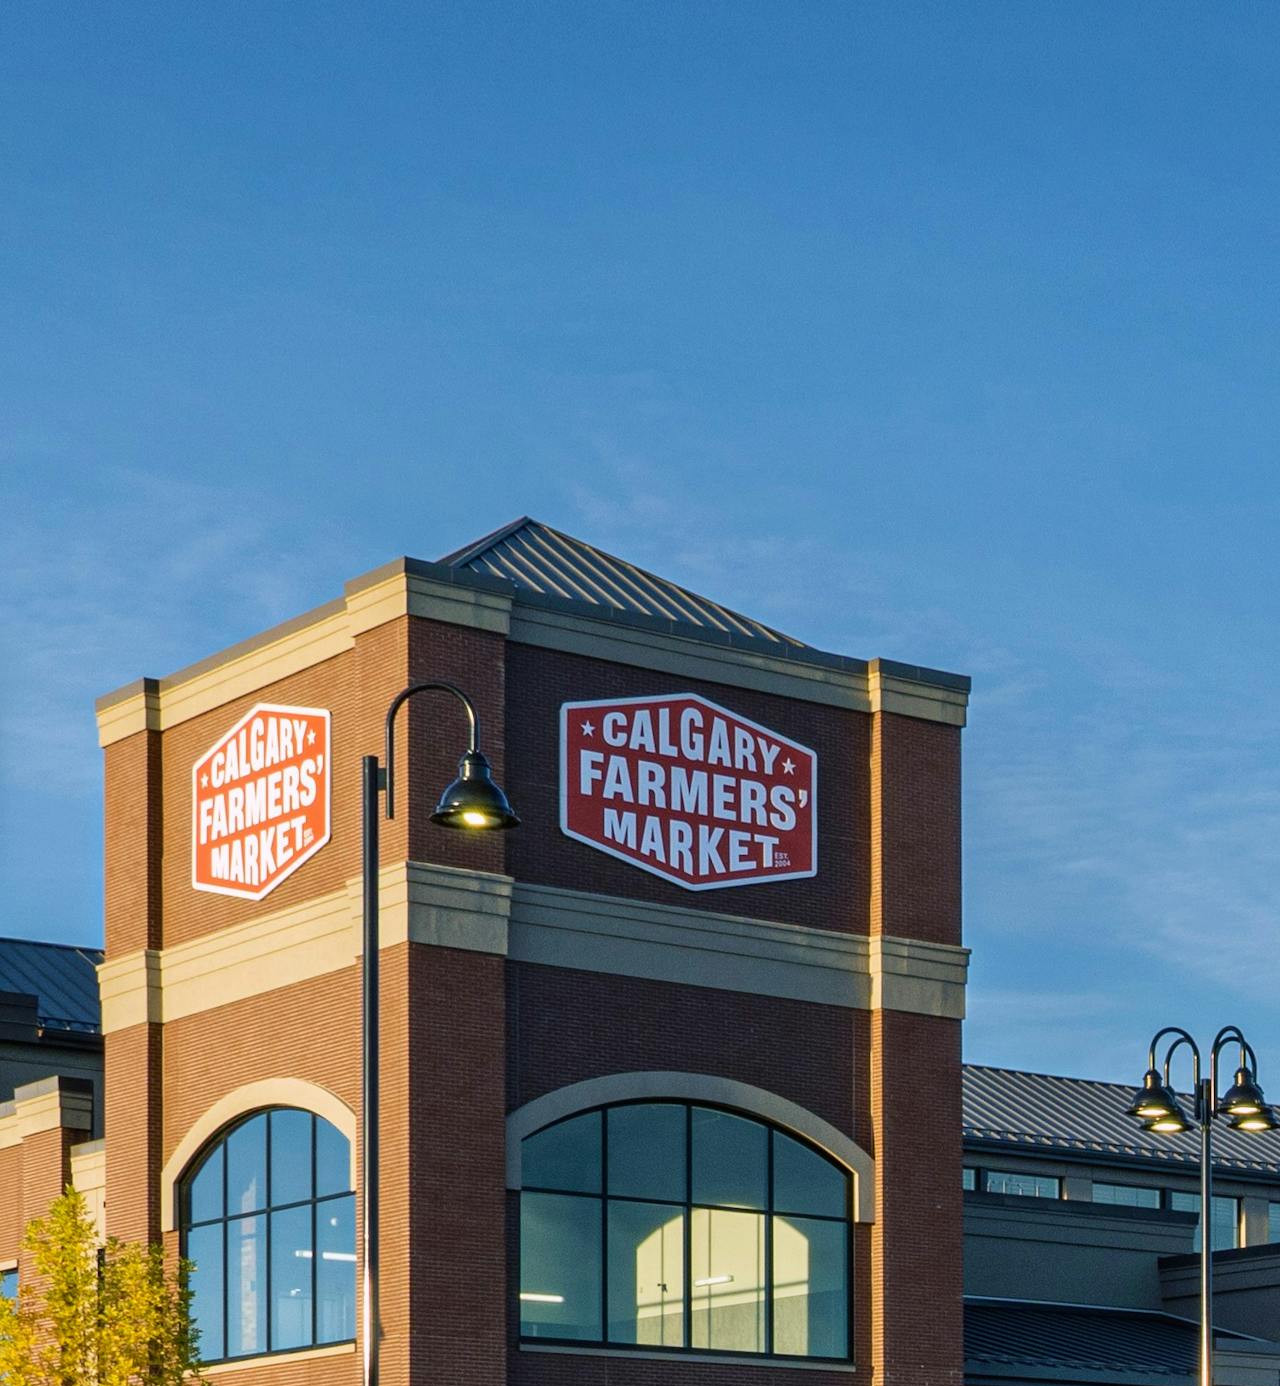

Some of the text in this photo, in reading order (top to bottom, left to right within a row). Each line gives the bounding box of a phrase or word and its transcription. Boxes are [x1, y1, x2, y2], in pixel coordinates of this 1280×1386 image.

[211, 717, 308, 789] CALGARY
[602, 707, 781, 775] CALGARY
[200, 754, 324, 845] FARMERS'
[580, 749, 808, 831] FARMERS'
[211, 815, 307, 886] MARKET
[603, 808, 780, 876] MARKET
